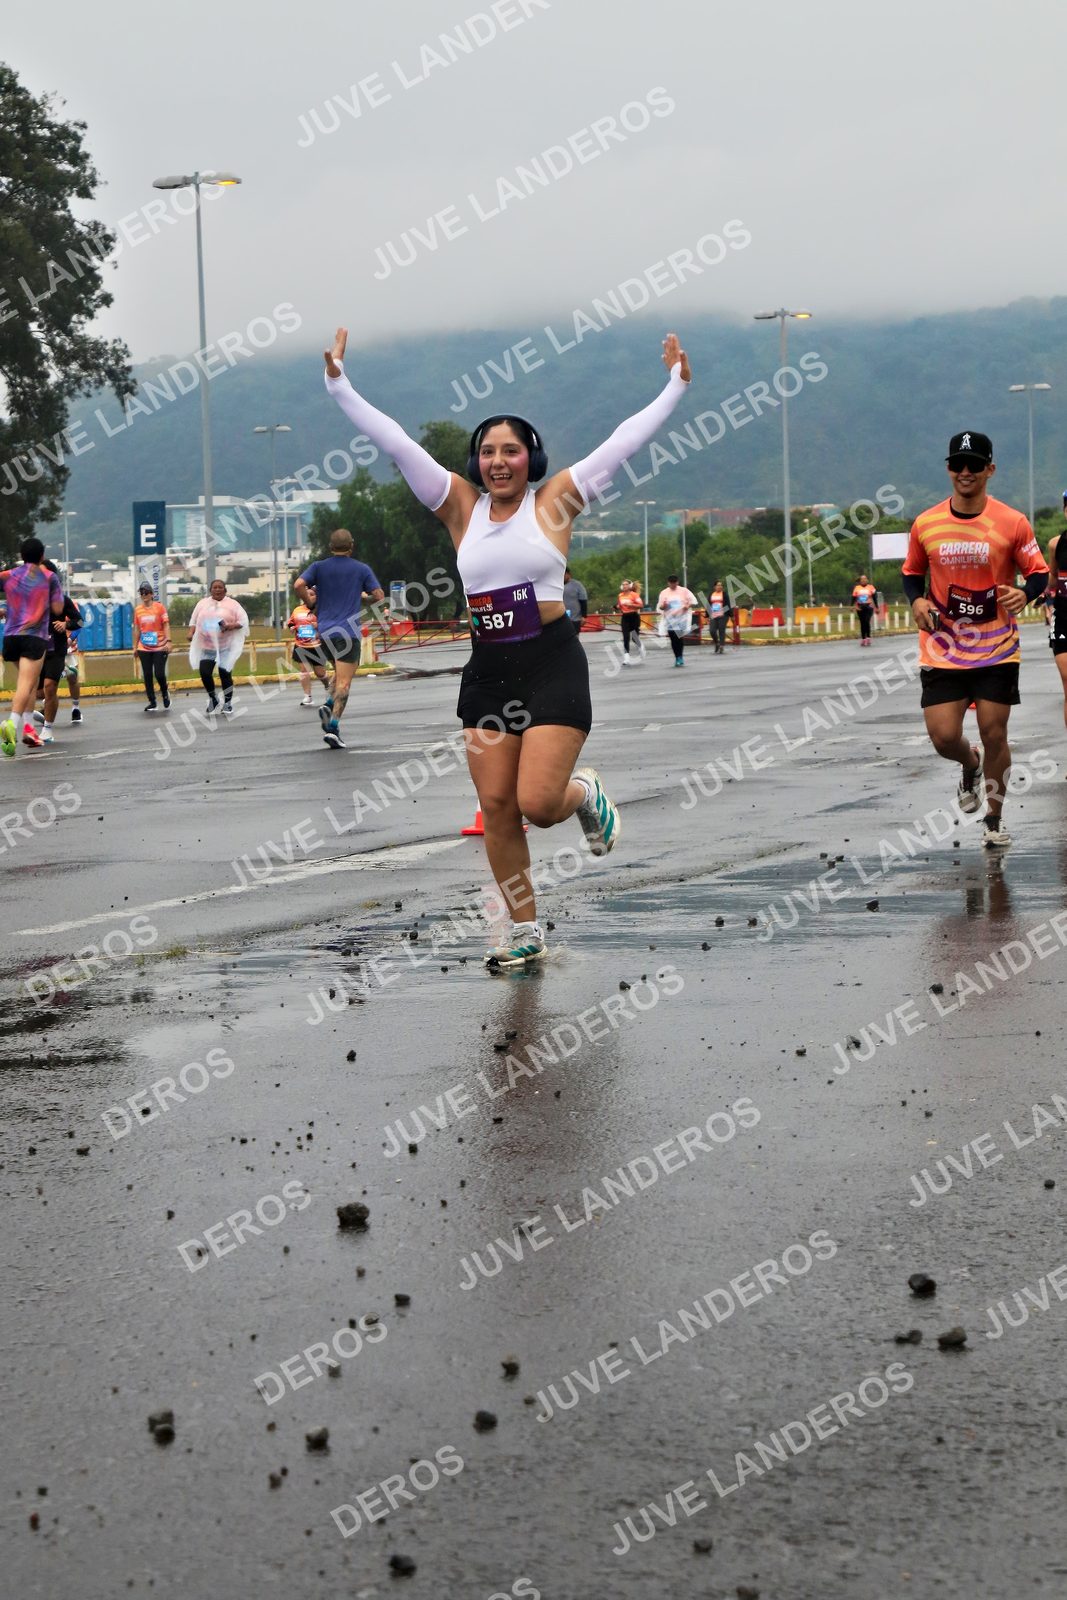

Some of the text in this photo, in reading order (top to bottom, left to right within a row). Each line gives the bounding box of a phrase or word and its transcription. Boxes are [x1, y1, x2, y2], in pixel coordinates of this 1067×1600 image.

[140, 524, 157, 547] E
[939, 541, 989, 557] CARRERA
[940, 555, 978, 565] OMNILIFE
[512, 588, 528, 601] 15K
[959, 602, 984, 615] 596
[481, 611, 514, 630] 587
